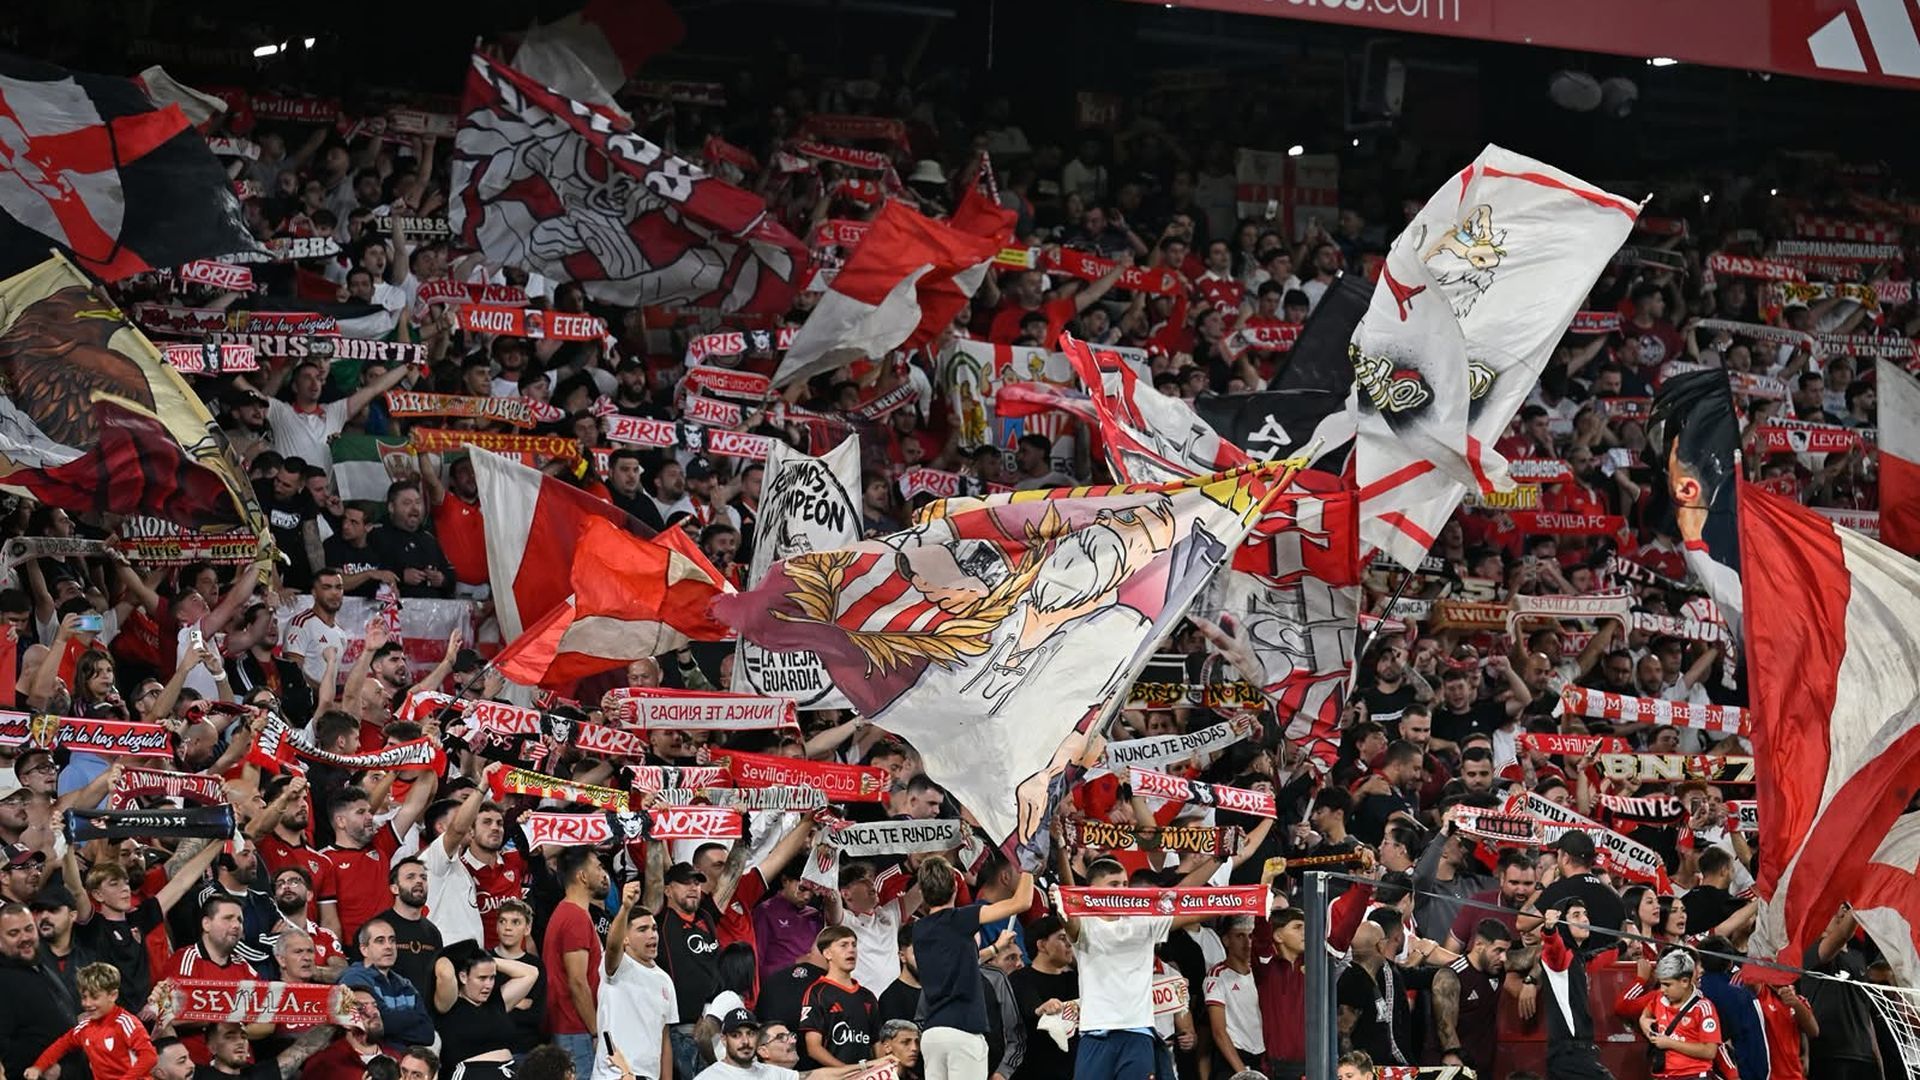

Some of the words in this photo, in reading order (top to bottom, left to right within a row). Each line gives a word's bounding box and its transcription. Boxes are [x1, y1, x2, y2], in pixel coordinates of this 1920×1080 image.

[182, 263, 243, 288] NORTE
[1081, 258, 1125, 283] SEVIA
[1126, 270, 1143, 285] FC
[470, 311, 514, 331] AMOR
[554, 314, 607, 335] ETERN
[331, 338, 428, 365] NORTE
[690, 333, 745, 357] IRIS
[169, 350, 203, 369] BIRIS
[693, 400, 739, 427] BIRIS
[614, 420, 674, 446] BIRIS
[908, 471, 956, 496] BIRIS
[1536, 514, 1583, 529] SEVILLA
[1584, 515, 1606, 530] FC
[761, 653, 775, 669] LA
[779, 652, 818, 669] VIEJA
[763, 671, 821, 694] GUARDIA
[74, 726, 92, 743] la
[475, 705, 540, 734] BIRIS
[579, 725, 641, 754] NORT
[1115, 741, 1160, 764] NUNCA
[1160, 739, 1179, 756] TE
[1181, 728, 1227, 752] RINDAS
[1138, 773, 1190, 800] BIRIS
[1219, 787, 1272, 813] NORTE
[1528, 796, 1579, 825] SEVILLA
[532, 815, 608, 840] BIRIS
[652, 811, 739, 837] NORTE
[828, 828, 879, 846] NUNCA
[879, 828, 900, 844] TE
[901, 825, 953, 843] RINDAS
[1082, 823, 1136, 849] BIRIS
[1160, 826, 1217, 853] NORTE
[1083, 895, 1151, 909] Sevillistas
[1181, 894, 1203, 910] San
[1205, 894, 1243, 910] Pablo
[192, 988, 300, 1014] SEVILLA
[303, 1003, 323, 1015] F.C.
